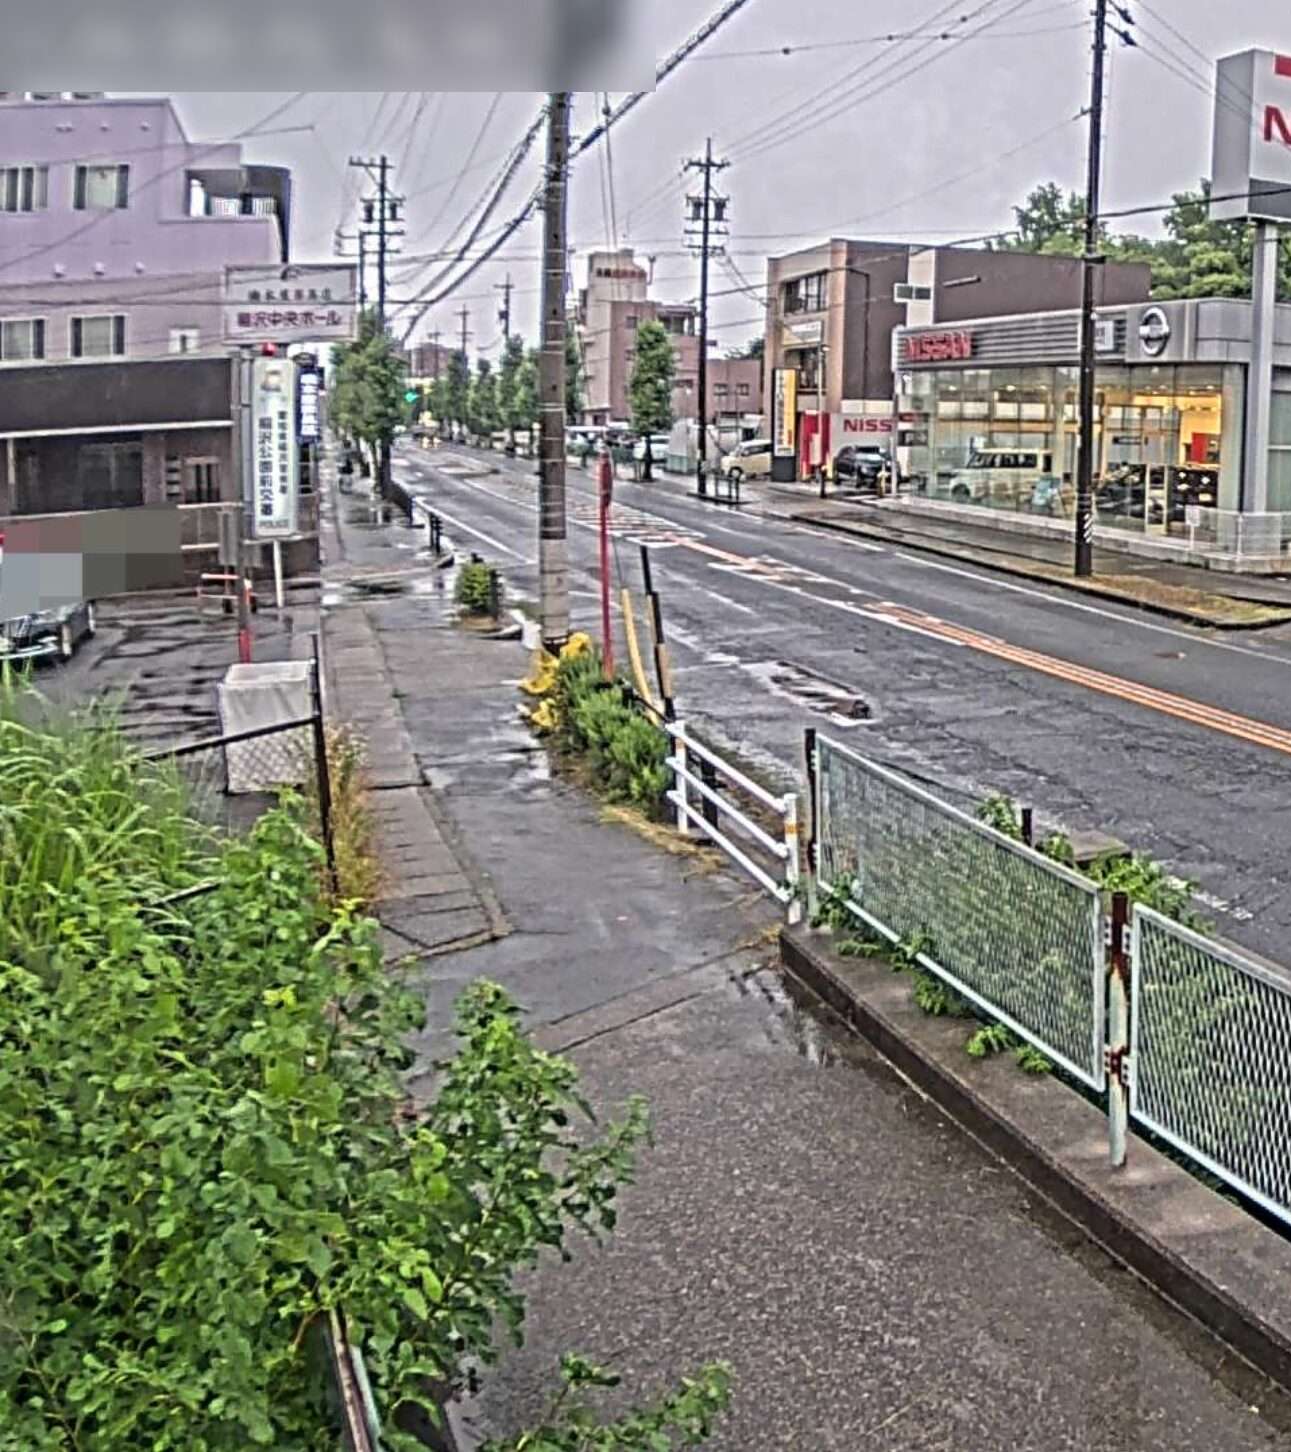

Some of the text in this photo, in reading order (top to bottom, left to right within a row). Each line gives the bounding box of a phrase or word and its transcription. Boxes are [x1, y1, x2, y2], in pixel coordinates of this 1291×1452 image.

[905, 331, 972, 361] NISSAN
[843, 418, 894, 433] NISS
[258, 416, 274, 516] 稲沢公園前交番
[259, 519, 289, 529] POLICE
